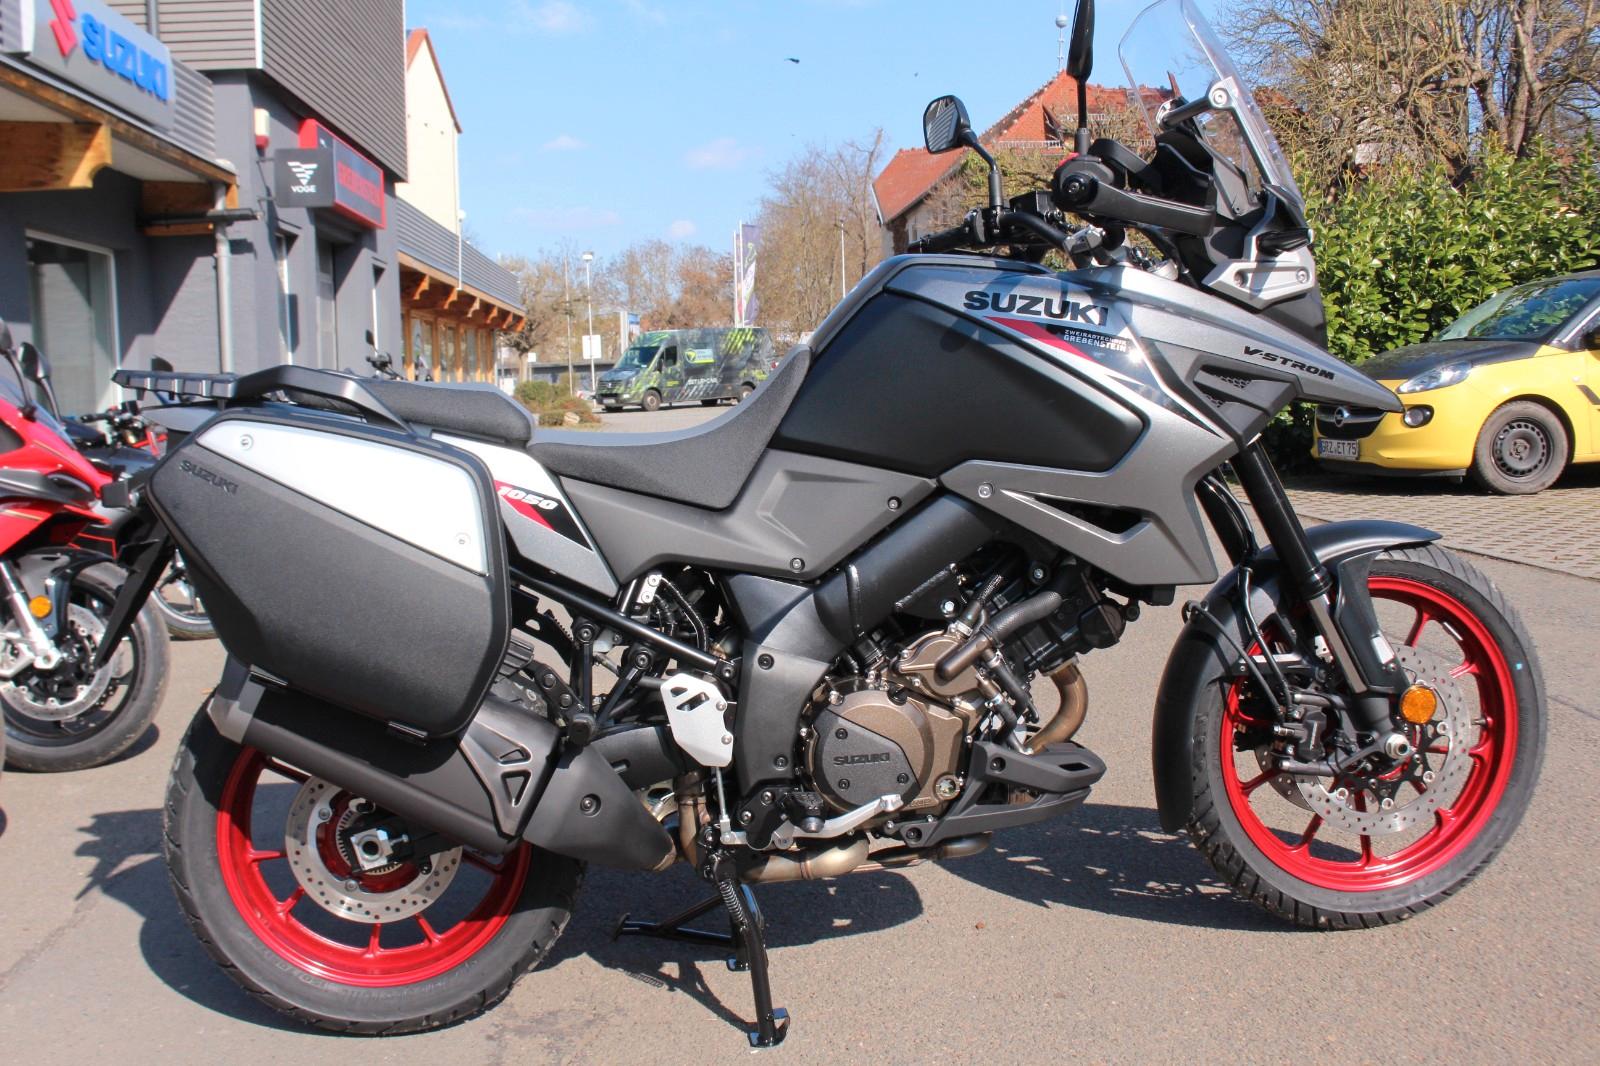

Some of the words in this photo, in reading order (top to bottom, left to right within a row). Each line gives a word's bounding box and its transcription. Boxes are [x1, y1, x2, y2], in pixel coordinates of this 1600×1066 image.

[82, 12, 168, 102] SUZUKI
[291, 184, 317, 193] VOGE
[963, 290, 1109, 326] SUZUKI
[1063, 335, 1127, 353] GREBENSTEIN
[1243, 346, 1335, 381] V-STROM
[179, 460, 239, 495] SUZUKI
[498, 486, 558, 510] 1050
[833, 753, 890, 766] SUZUKI
